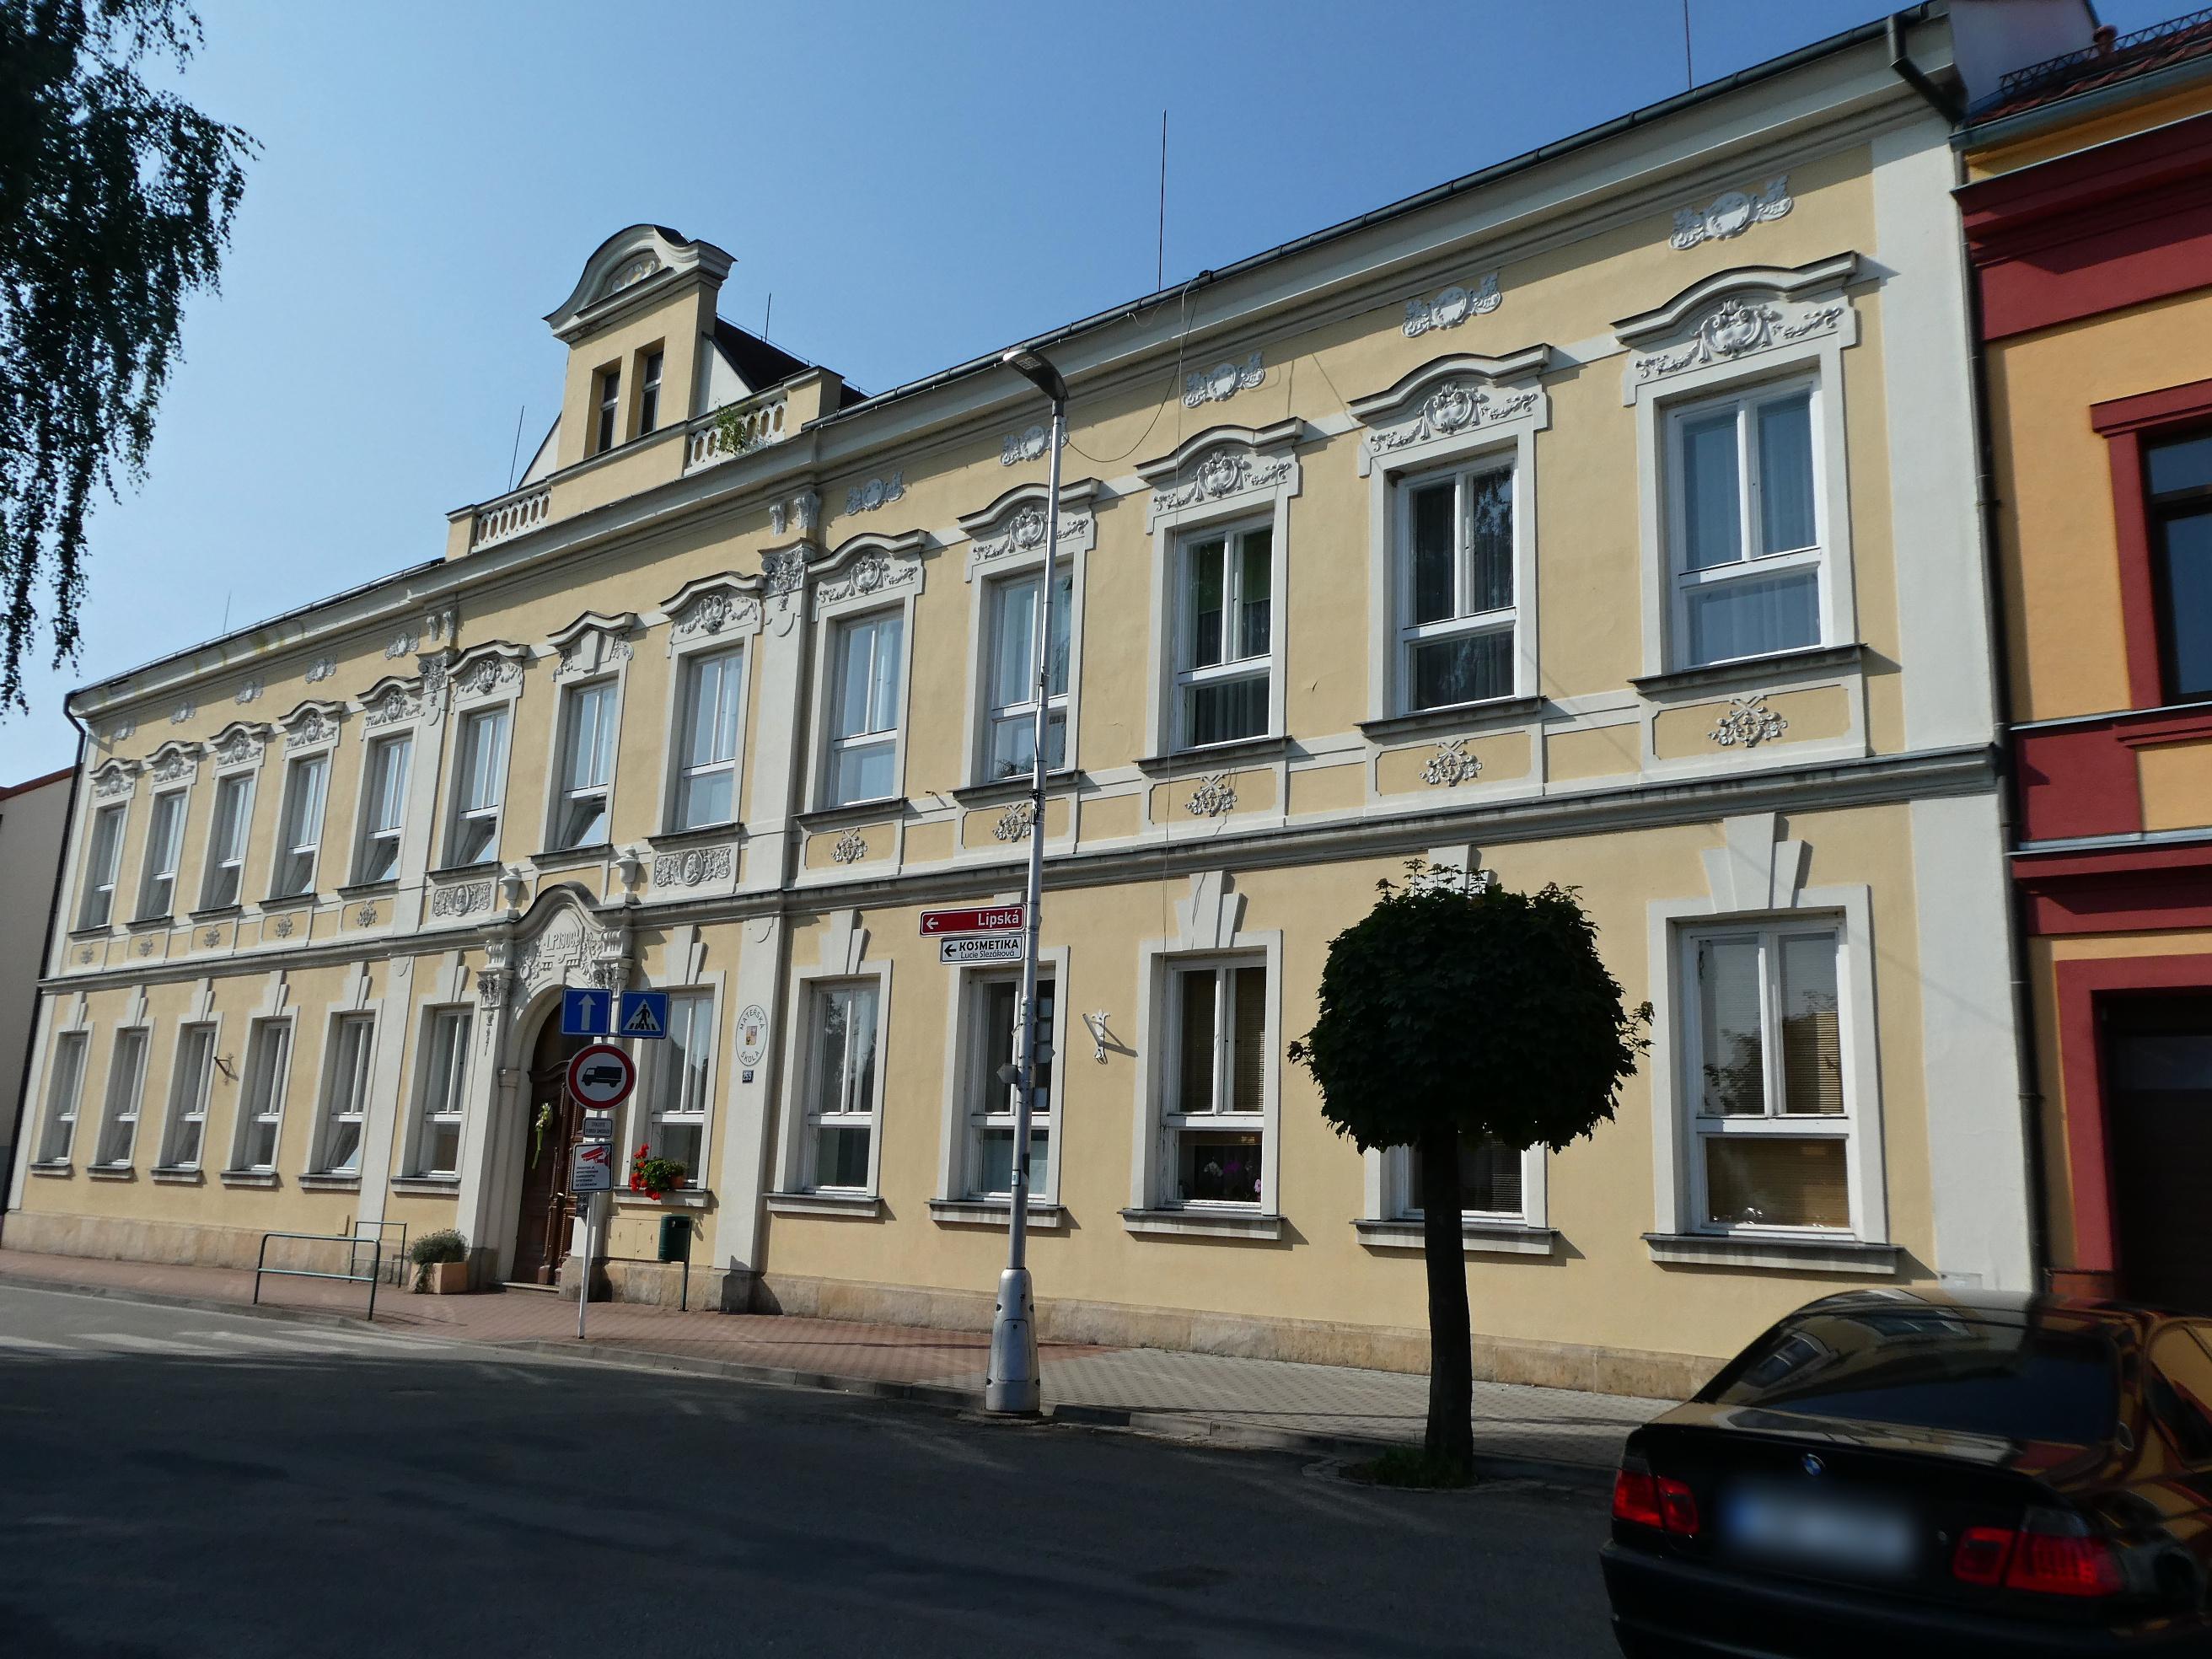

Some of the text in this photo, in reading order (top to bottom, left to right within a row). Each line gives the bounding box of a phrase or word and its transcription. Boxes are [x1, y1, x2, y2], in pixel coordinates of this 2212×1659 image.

[978, 910, 1018, 927] Lipská
[959, 939, 1018, 952] KOSMETIKA
[961, 951, 979, 959] Lucie
